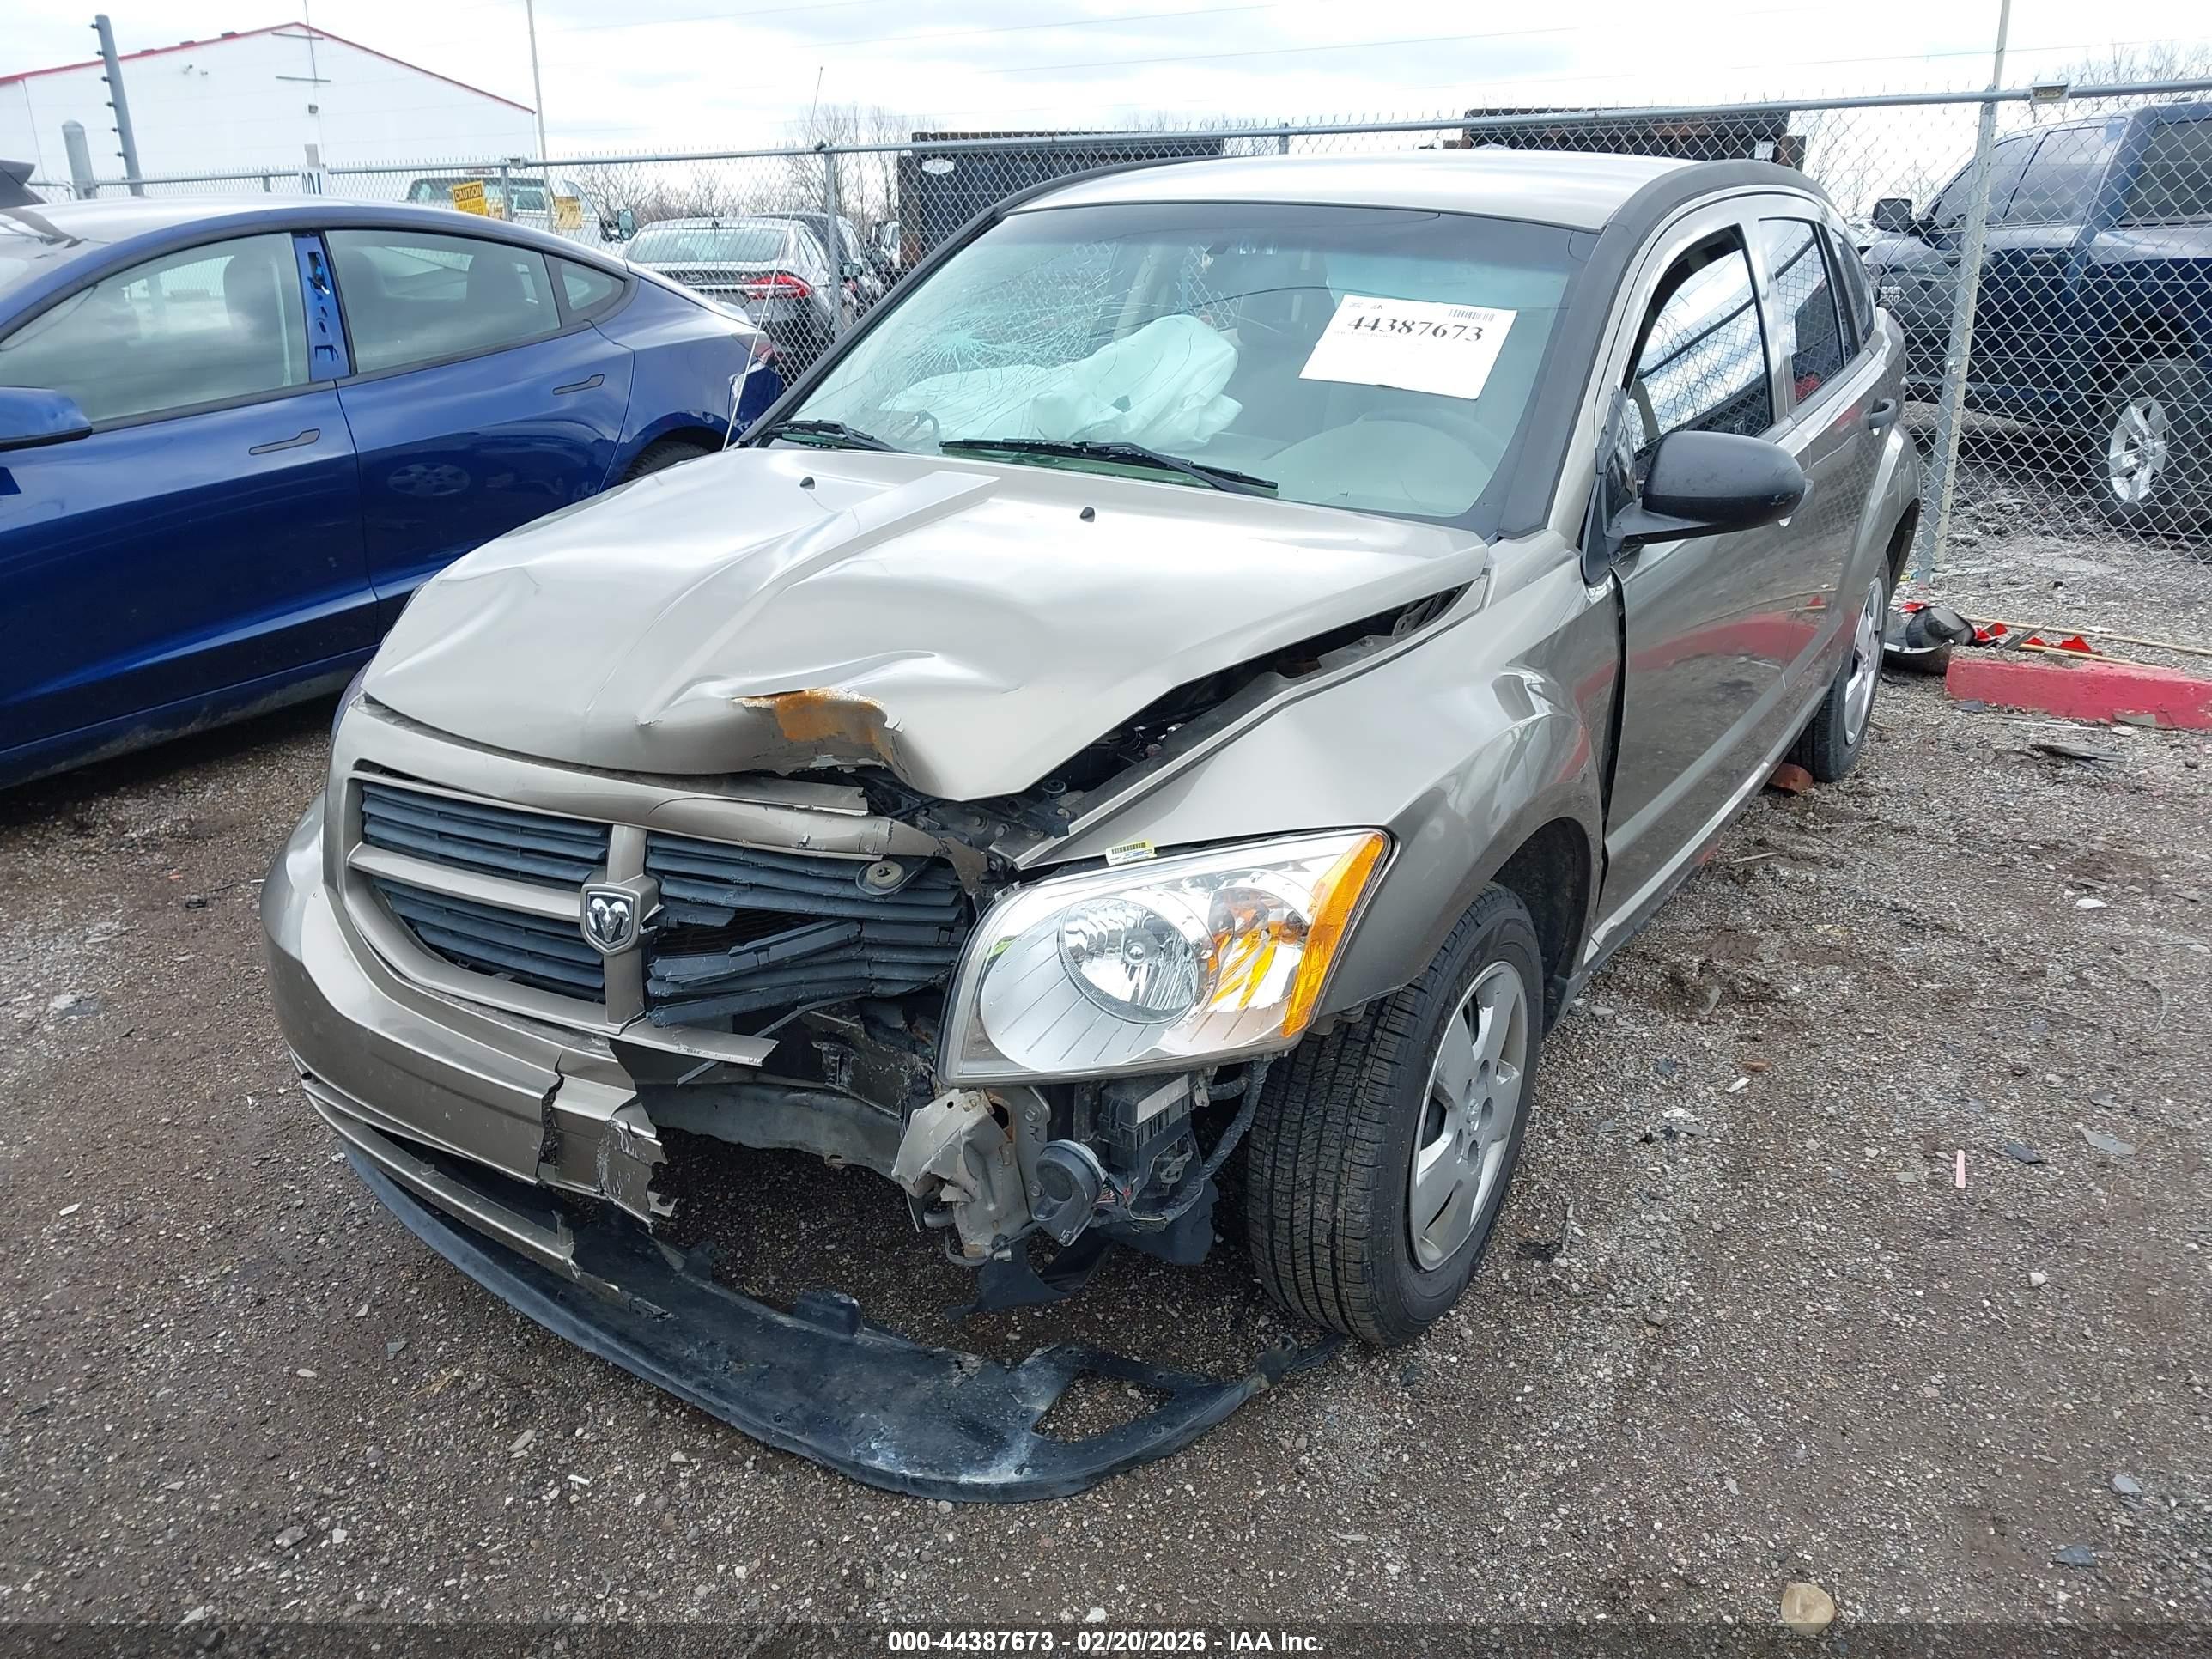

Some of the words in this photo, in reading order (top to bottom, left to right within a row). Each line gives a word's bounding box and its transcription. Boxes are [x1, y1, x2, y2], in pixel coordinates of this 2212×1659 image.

[454, 185, 482, 201] CAUTION
[1881, 286, 1901, 295] RAM
[1346, 316, 1484, 342] 44387673
